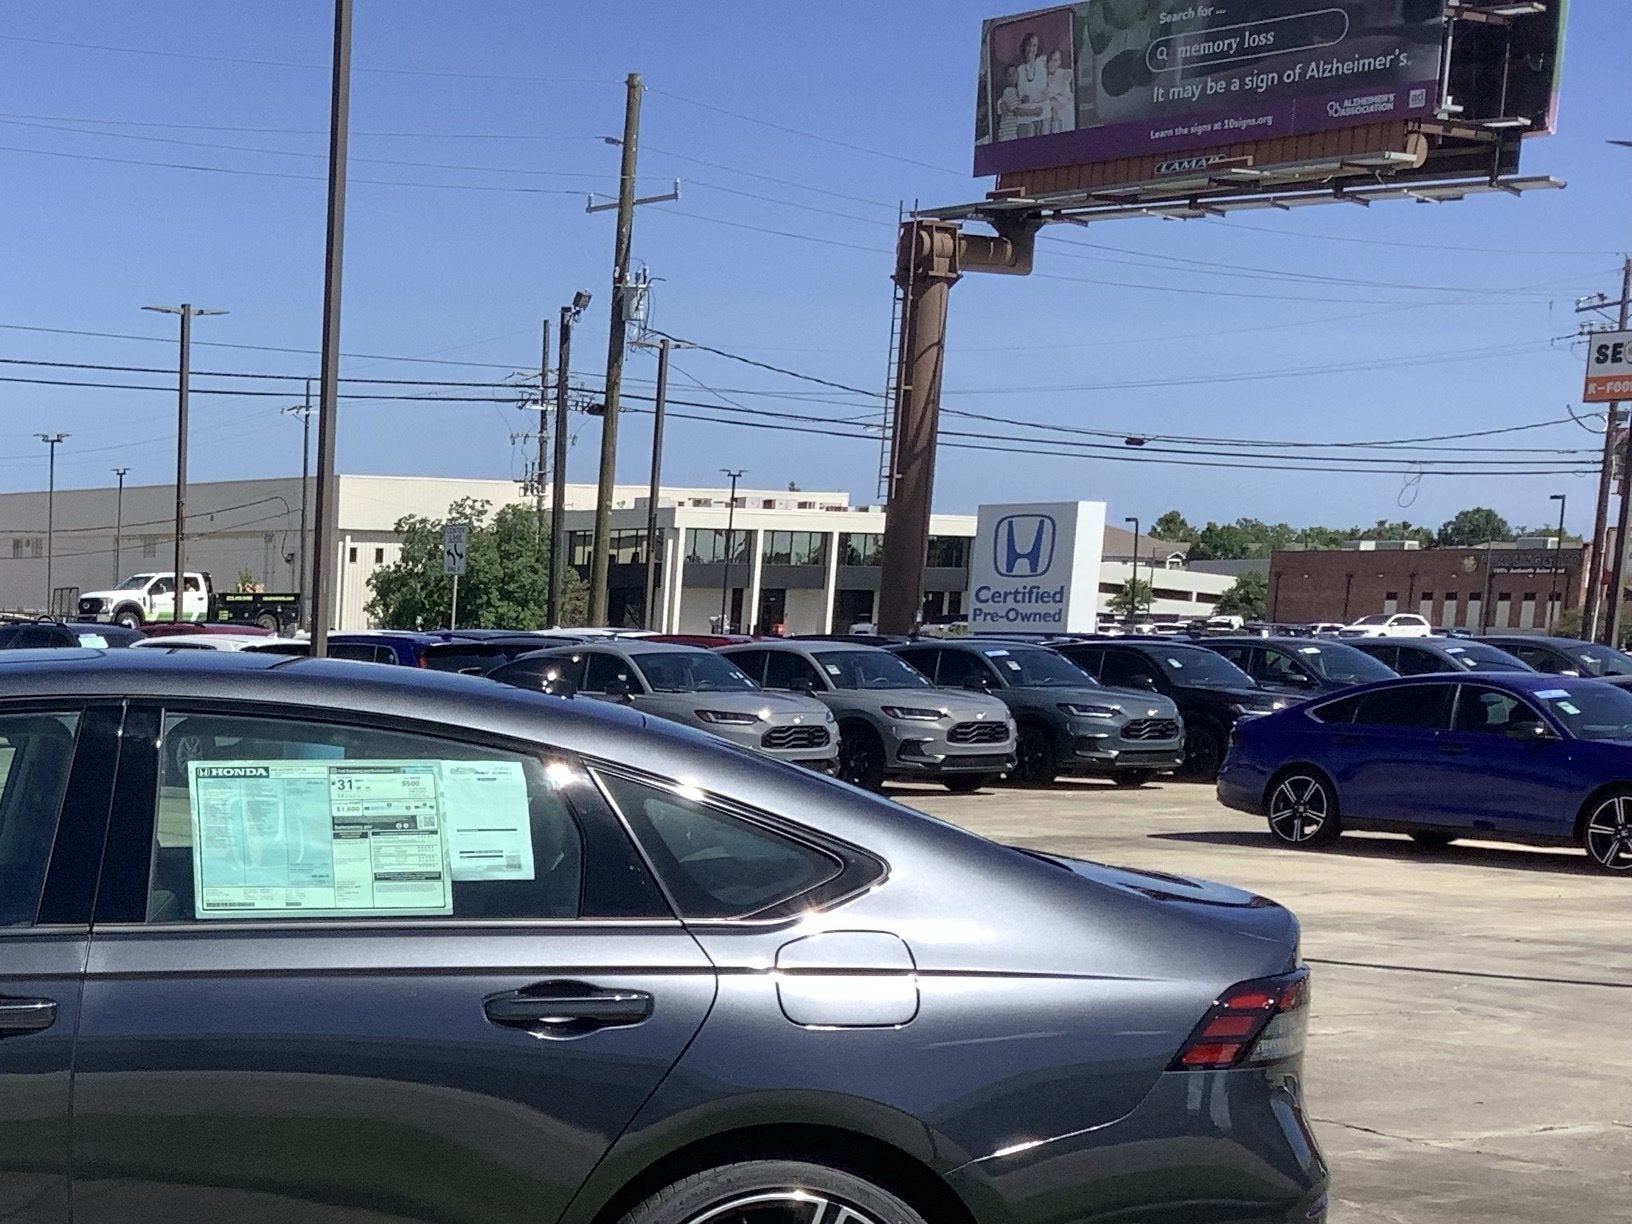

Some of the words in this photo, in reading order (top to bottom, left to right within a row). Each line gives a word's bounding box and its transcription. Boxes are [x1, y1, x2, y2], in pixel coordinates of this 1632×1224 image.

[1159, 8, 1195, 25] Search
[1197, 5, 1214, 19] for
[1177, 36, 1240, 58] memory
[1244, 29, 1275, 48] loss
[1153, 86, 1165, 103] It
[1169, 81, 1202, 101] may
[1206, 77, 1226, 94] be
[1231, 77, 1240, 91] a
[1245, 69, 1279, 92] sign
[1283, 63, 1304, 83] of
[1150, 129, 1173, 140] Learn
[1175, 126, 1189, 135] the
[1191, 122, 1211, 136] signs
[1587, 380, 1632, 395] K-FOO
[974, 585, 1065, 604] Certified
[972, 608, 1063, 623] Pre-Owned
[211, 767, 268, 777] HONDA
[337, 779, 353, 791] 31
